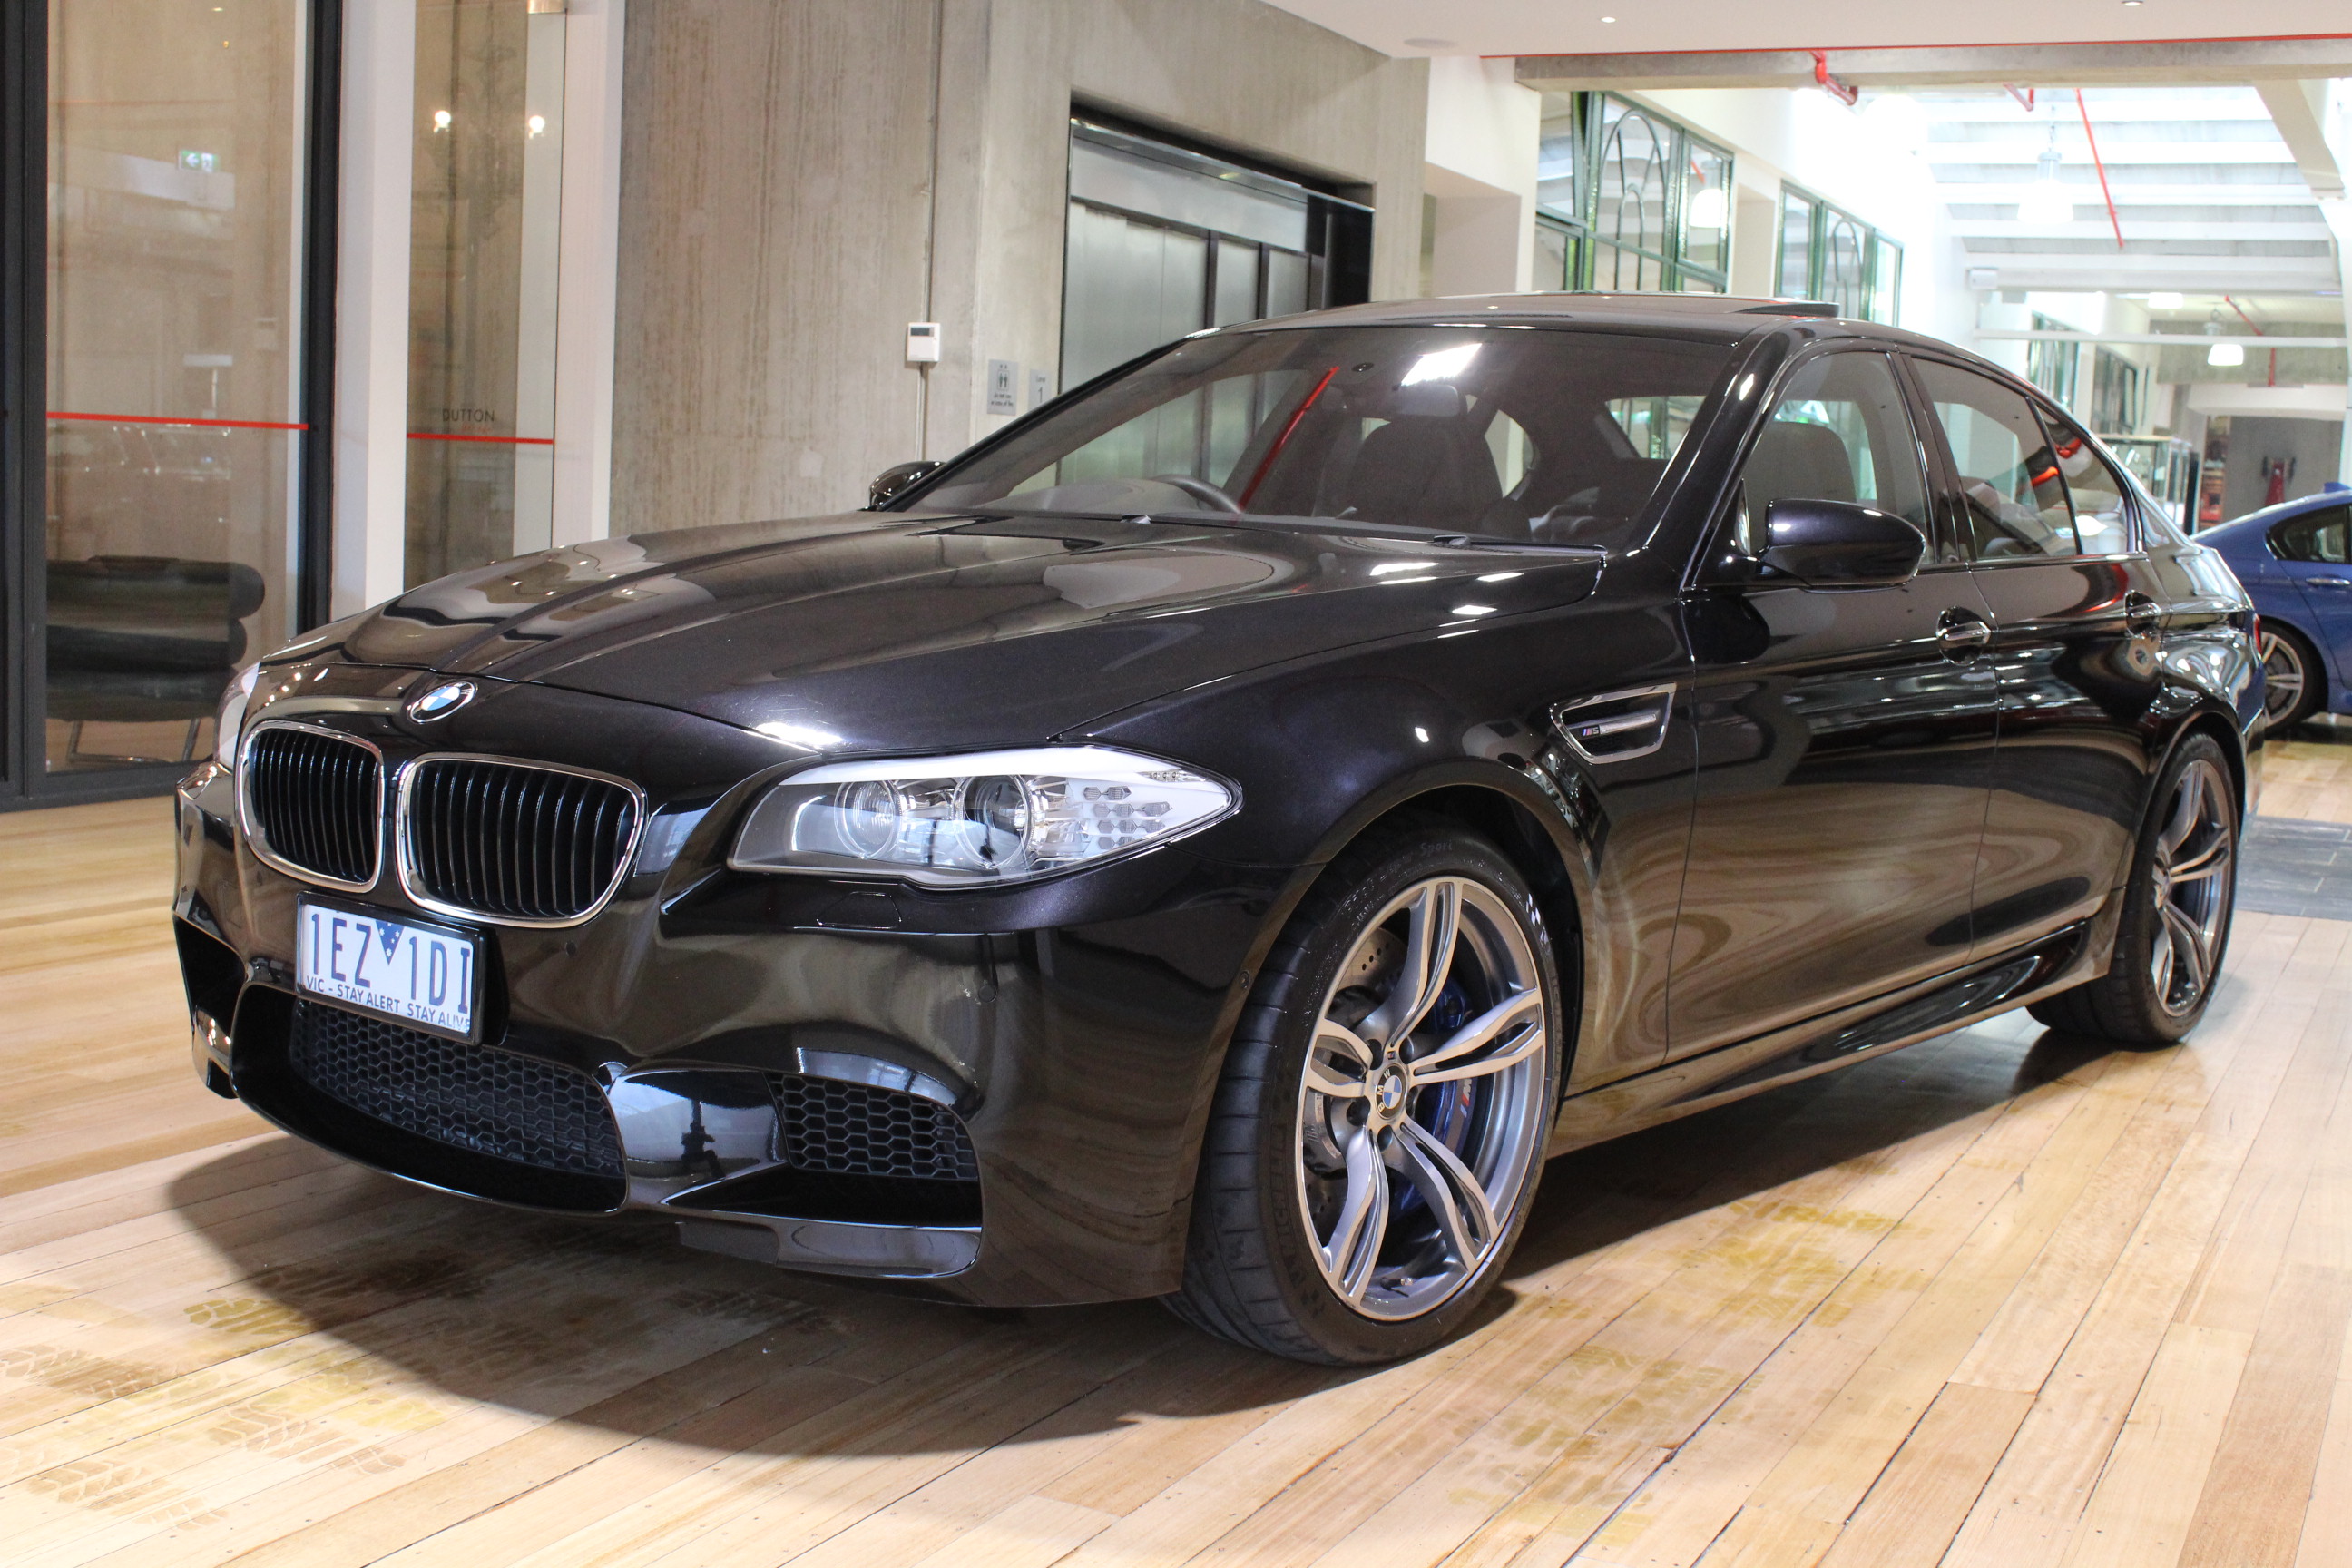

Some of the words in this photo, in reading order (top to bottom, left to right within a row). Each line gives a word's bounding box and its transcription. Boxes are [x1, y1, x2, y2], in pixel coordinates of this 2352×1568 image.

[442, 408, 495, 423] DUTTON
[307, 975, 324, 993] VIC
[338, 984, 364, 1002] STAY
[367, 993, 400, 1013] ALERT
[408, 1003, 436, 1022] STAY
